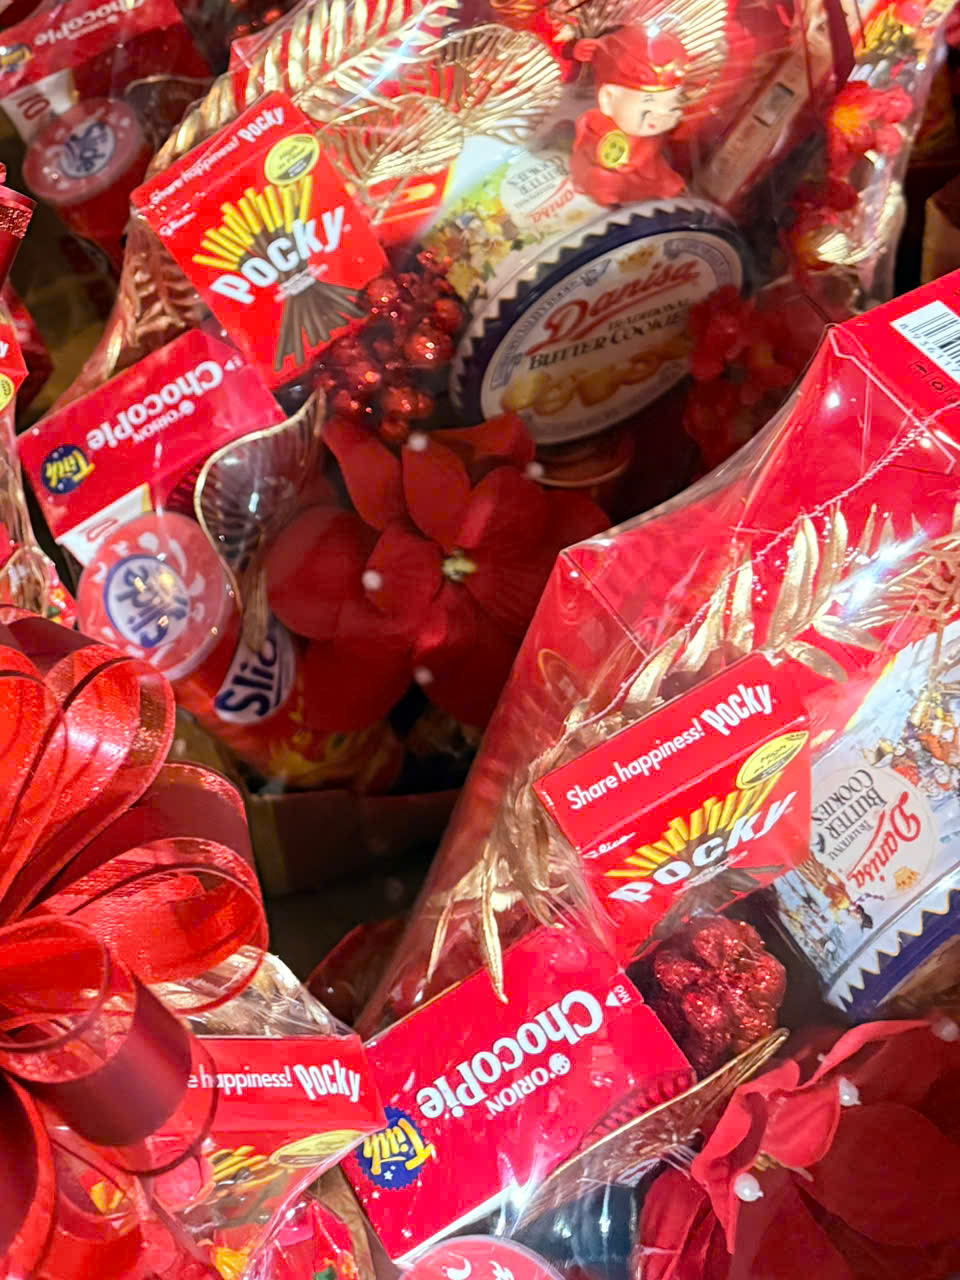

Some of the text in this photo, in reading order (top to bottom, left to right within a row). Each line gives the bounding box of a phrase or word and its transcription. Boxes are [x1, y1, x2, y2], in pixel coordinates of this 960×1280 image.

[566, 777, 619, 811] Share
[614, 718, 705, 783] happiness!
[416, 990, 603, 1119] ChocoPie
[486, 1067, 549, 1116] ORION
